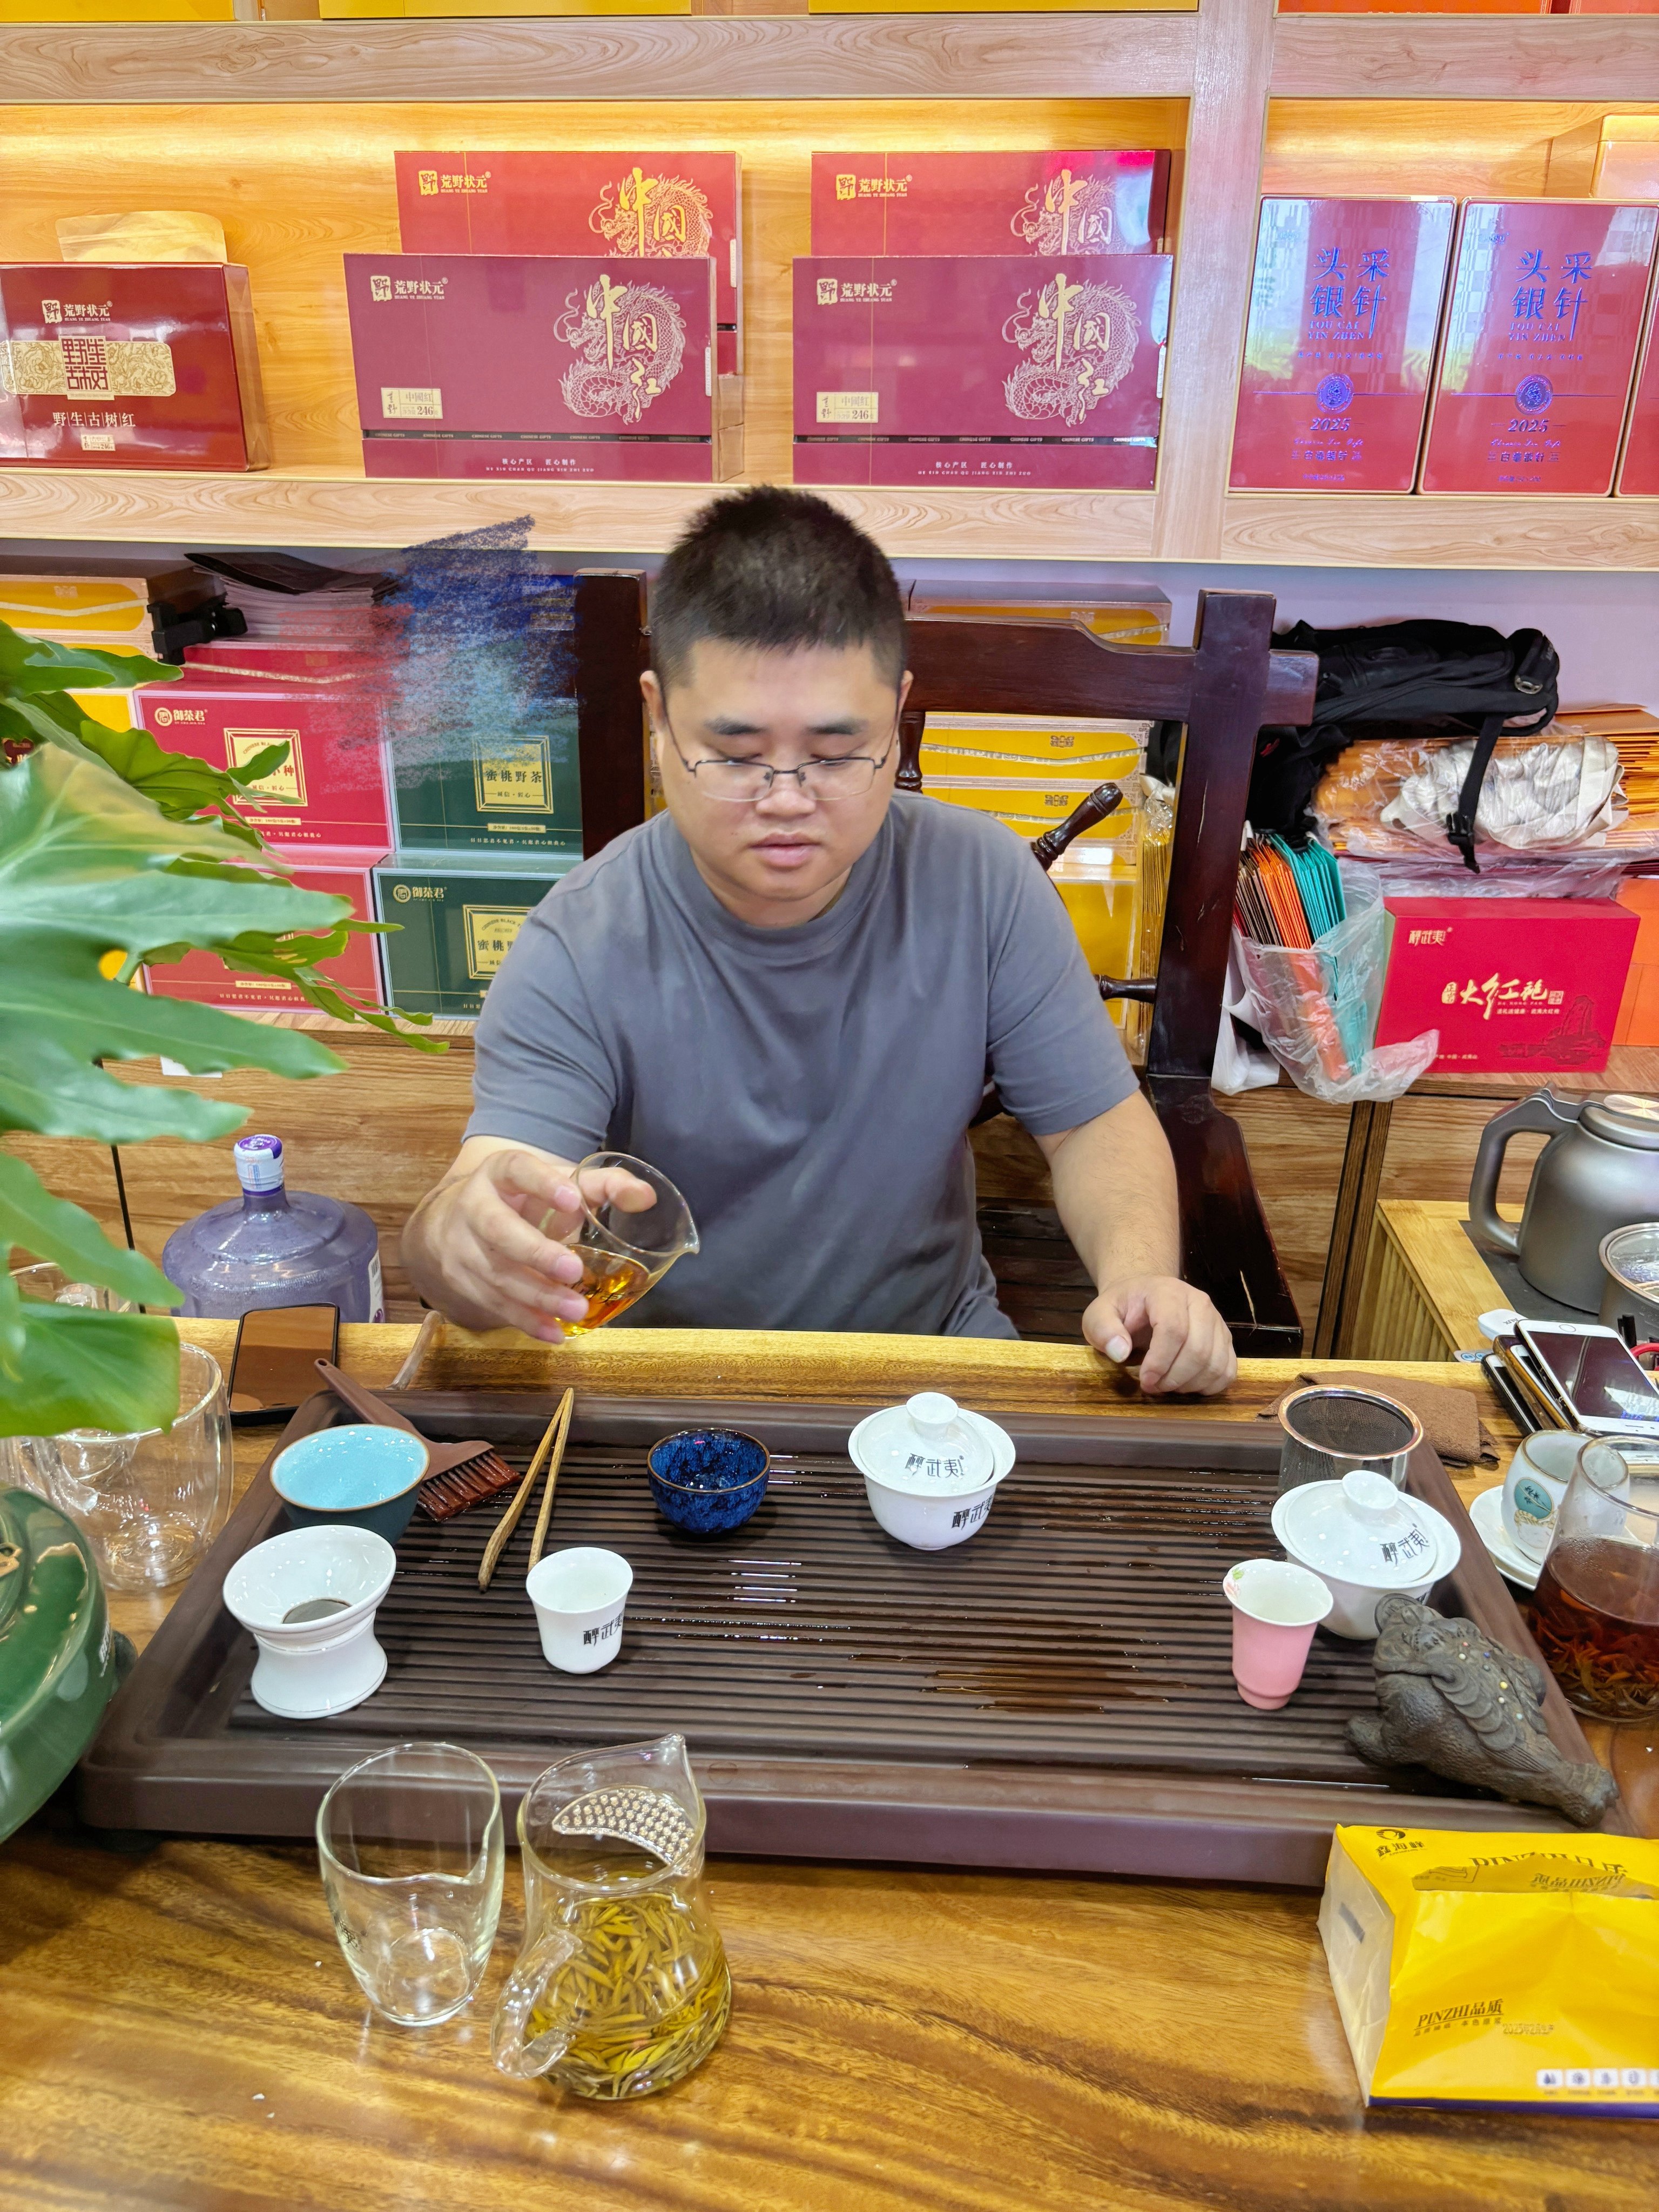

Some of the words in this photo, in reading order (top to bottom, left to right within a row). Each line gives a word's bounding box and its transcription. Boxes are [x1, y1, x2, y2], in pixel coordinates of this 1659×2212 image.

[441, 174, 488, 188] 荒野状元
[859, 178, 907, 192] 荒野状元
[394, 280, 444, 294] 荒野状元
[840, 282, 892, 297] 荒野状元
[63, 304, 110, 317] 荒野状元
[417, 406, 433, 415] 246
[852, 410, 868, 419] 246
[1310, 417, 1351, 431] 2025
[1508, 419, 1549, 432] 2025
[173, 709, 205, 721] 御茶君
[486, 770, 542, 784] 蜜桃野茶
[412, 886, 444, 899] 御茶君
[905, 1453, 959, 1478] 醉武夷
[1379, 1530, 1430, 1566] 醉武夷
[1418, 1998, 1503, 2027] PINZHI品质
